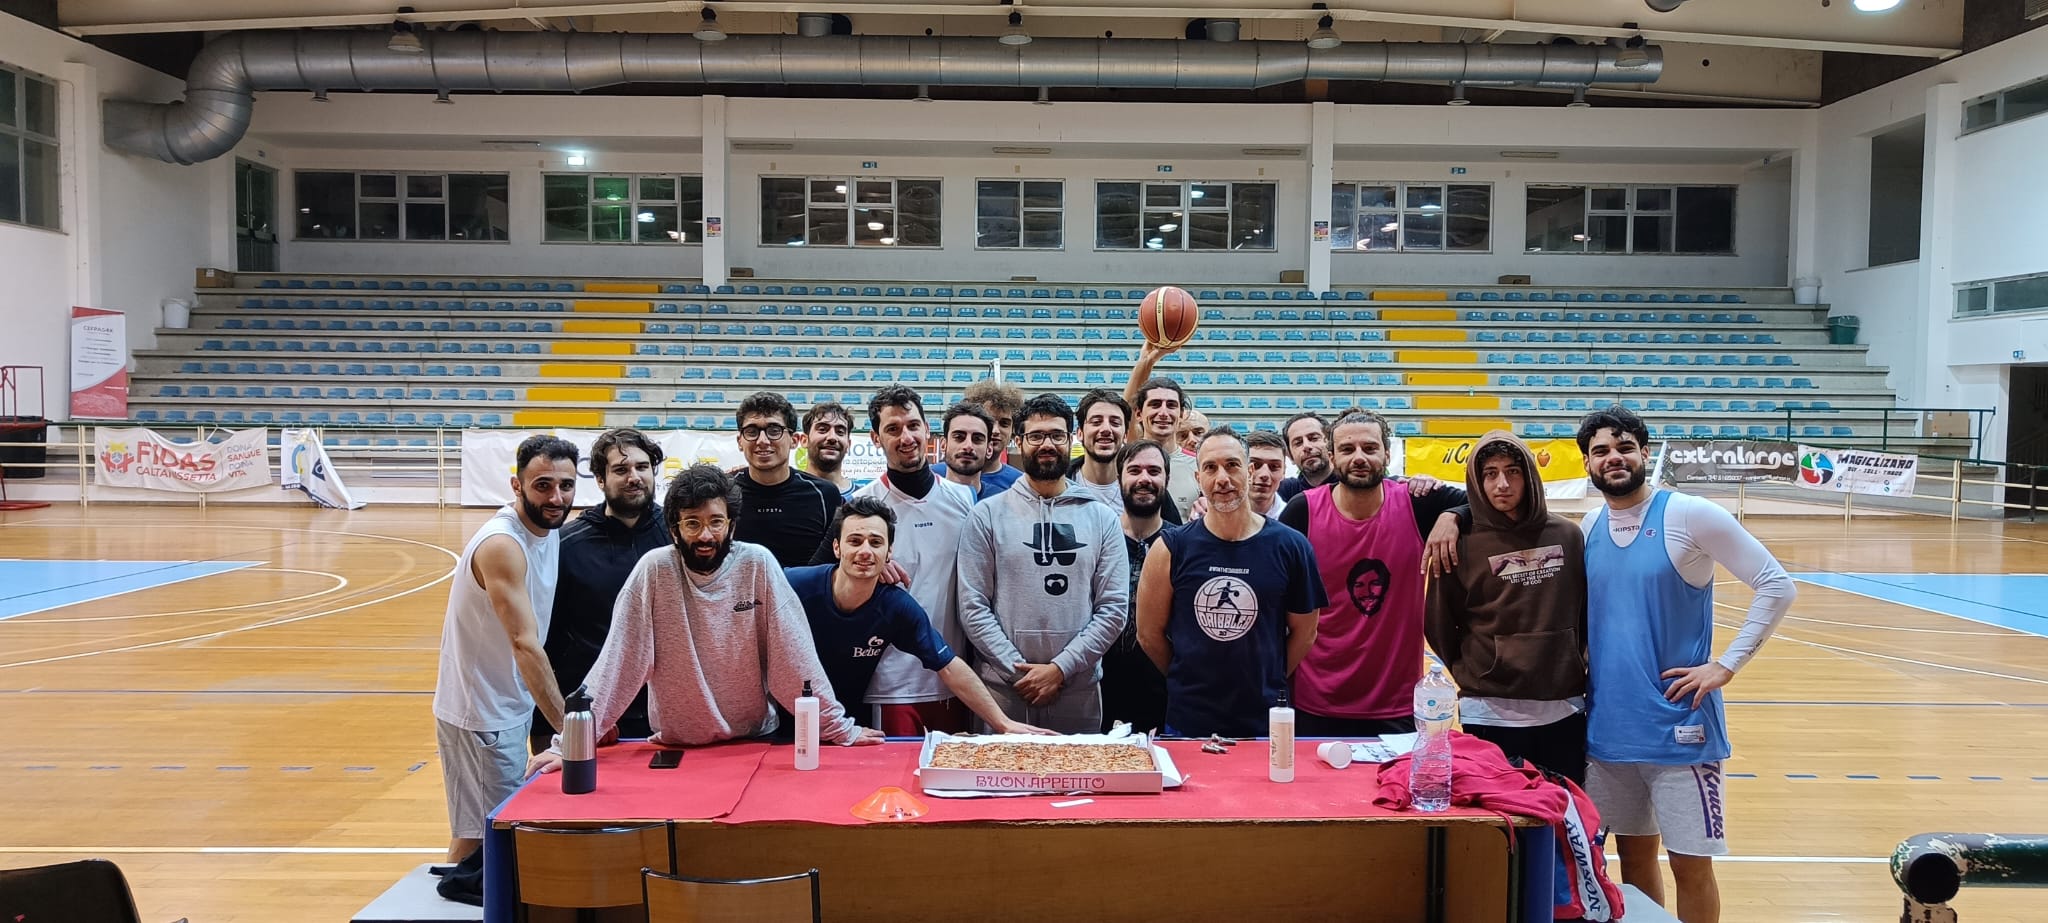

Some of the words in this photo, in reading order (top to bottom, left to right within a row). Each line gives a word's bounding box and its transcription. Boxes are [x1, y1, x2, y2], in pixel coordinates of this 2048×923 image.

[137, 441, 217, 472] FIDAS
[1670, 446, 1795, 470] extralarge
[1837, 454, 1914, 470] MAGICLIZARD
[136, 466, 217, 481] CALTANISSETTA
[228, 470, 247, 478] VITA
[976, 775, 1025, 789] BUON
[1027, 777, 1105, 789] APPETITO
[1564, 817, 1600, 912] NORWAY
